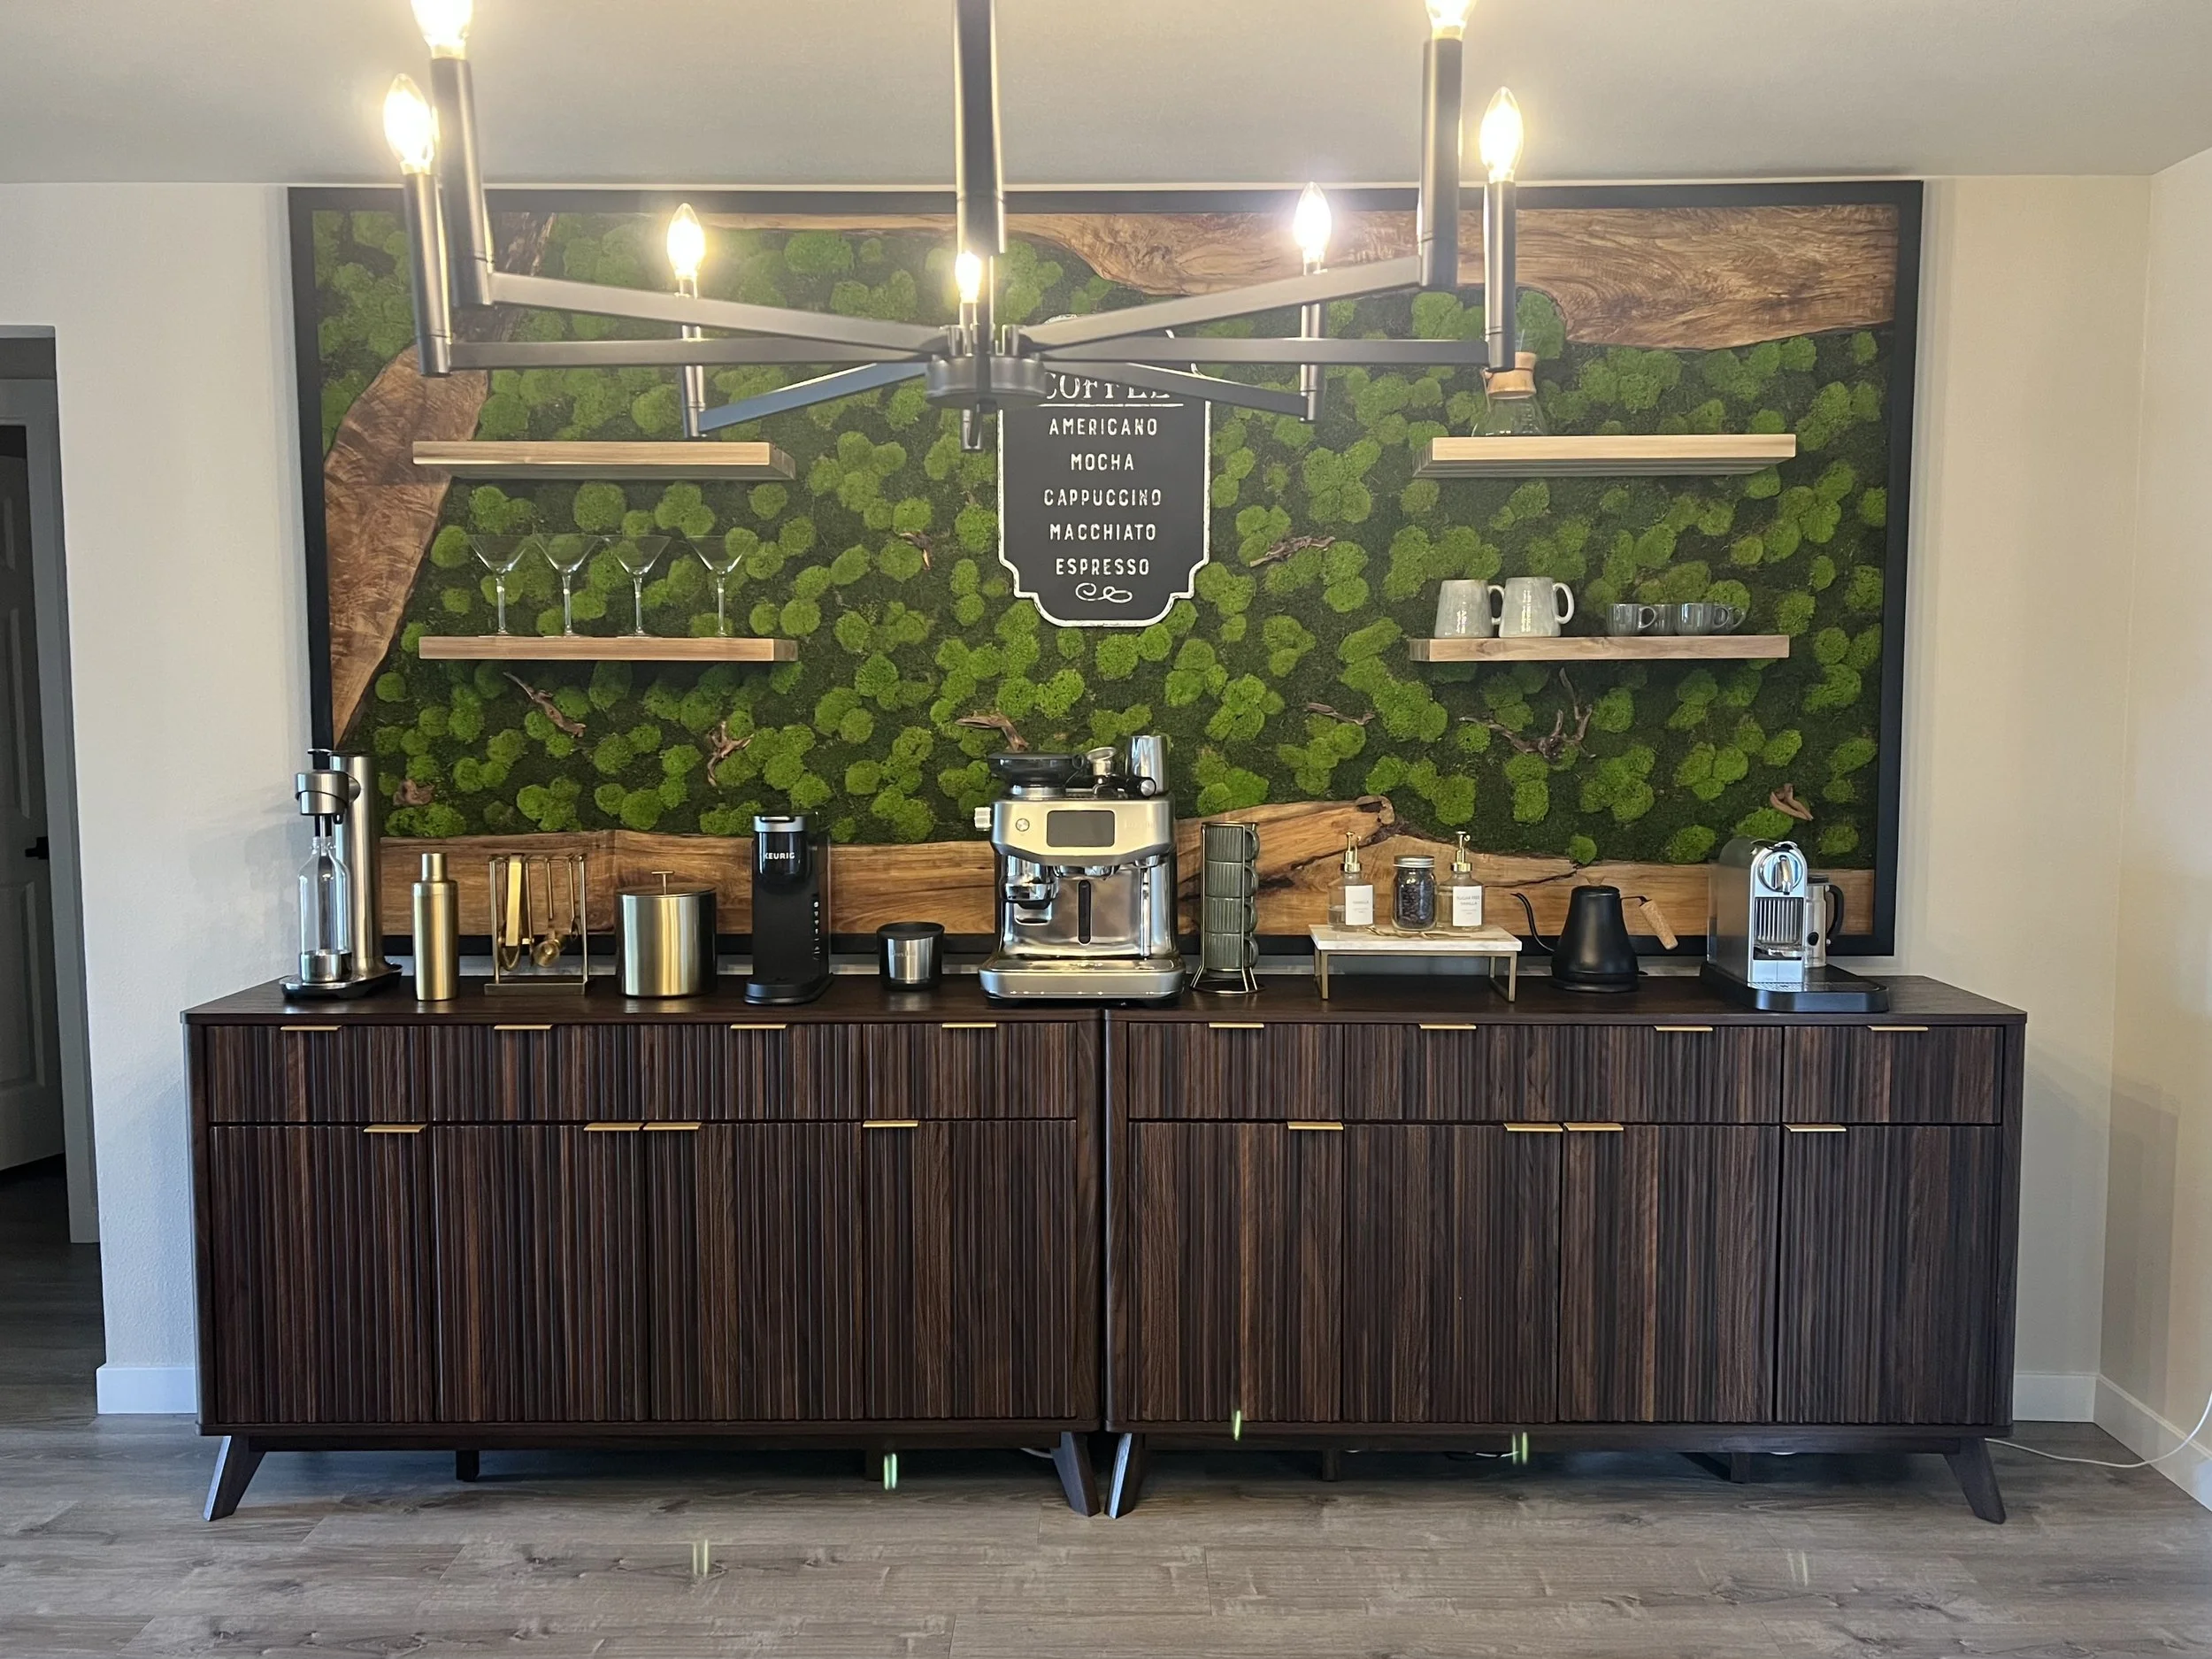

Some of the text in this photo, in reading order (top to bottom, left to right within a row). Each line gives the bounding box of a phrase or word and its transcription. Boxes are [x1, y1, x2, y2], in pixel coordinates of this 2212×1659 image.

[1048, 418, 1157, 435] AMERICANO
[1071, 453, 1134, 471] MOCHA
[1043, 488, 1162, 506] CAPPUCCINO
[1049, 523, 1156, 541] MACCHIATO
[1056, 557, 1149, 575] ESPRESSO
